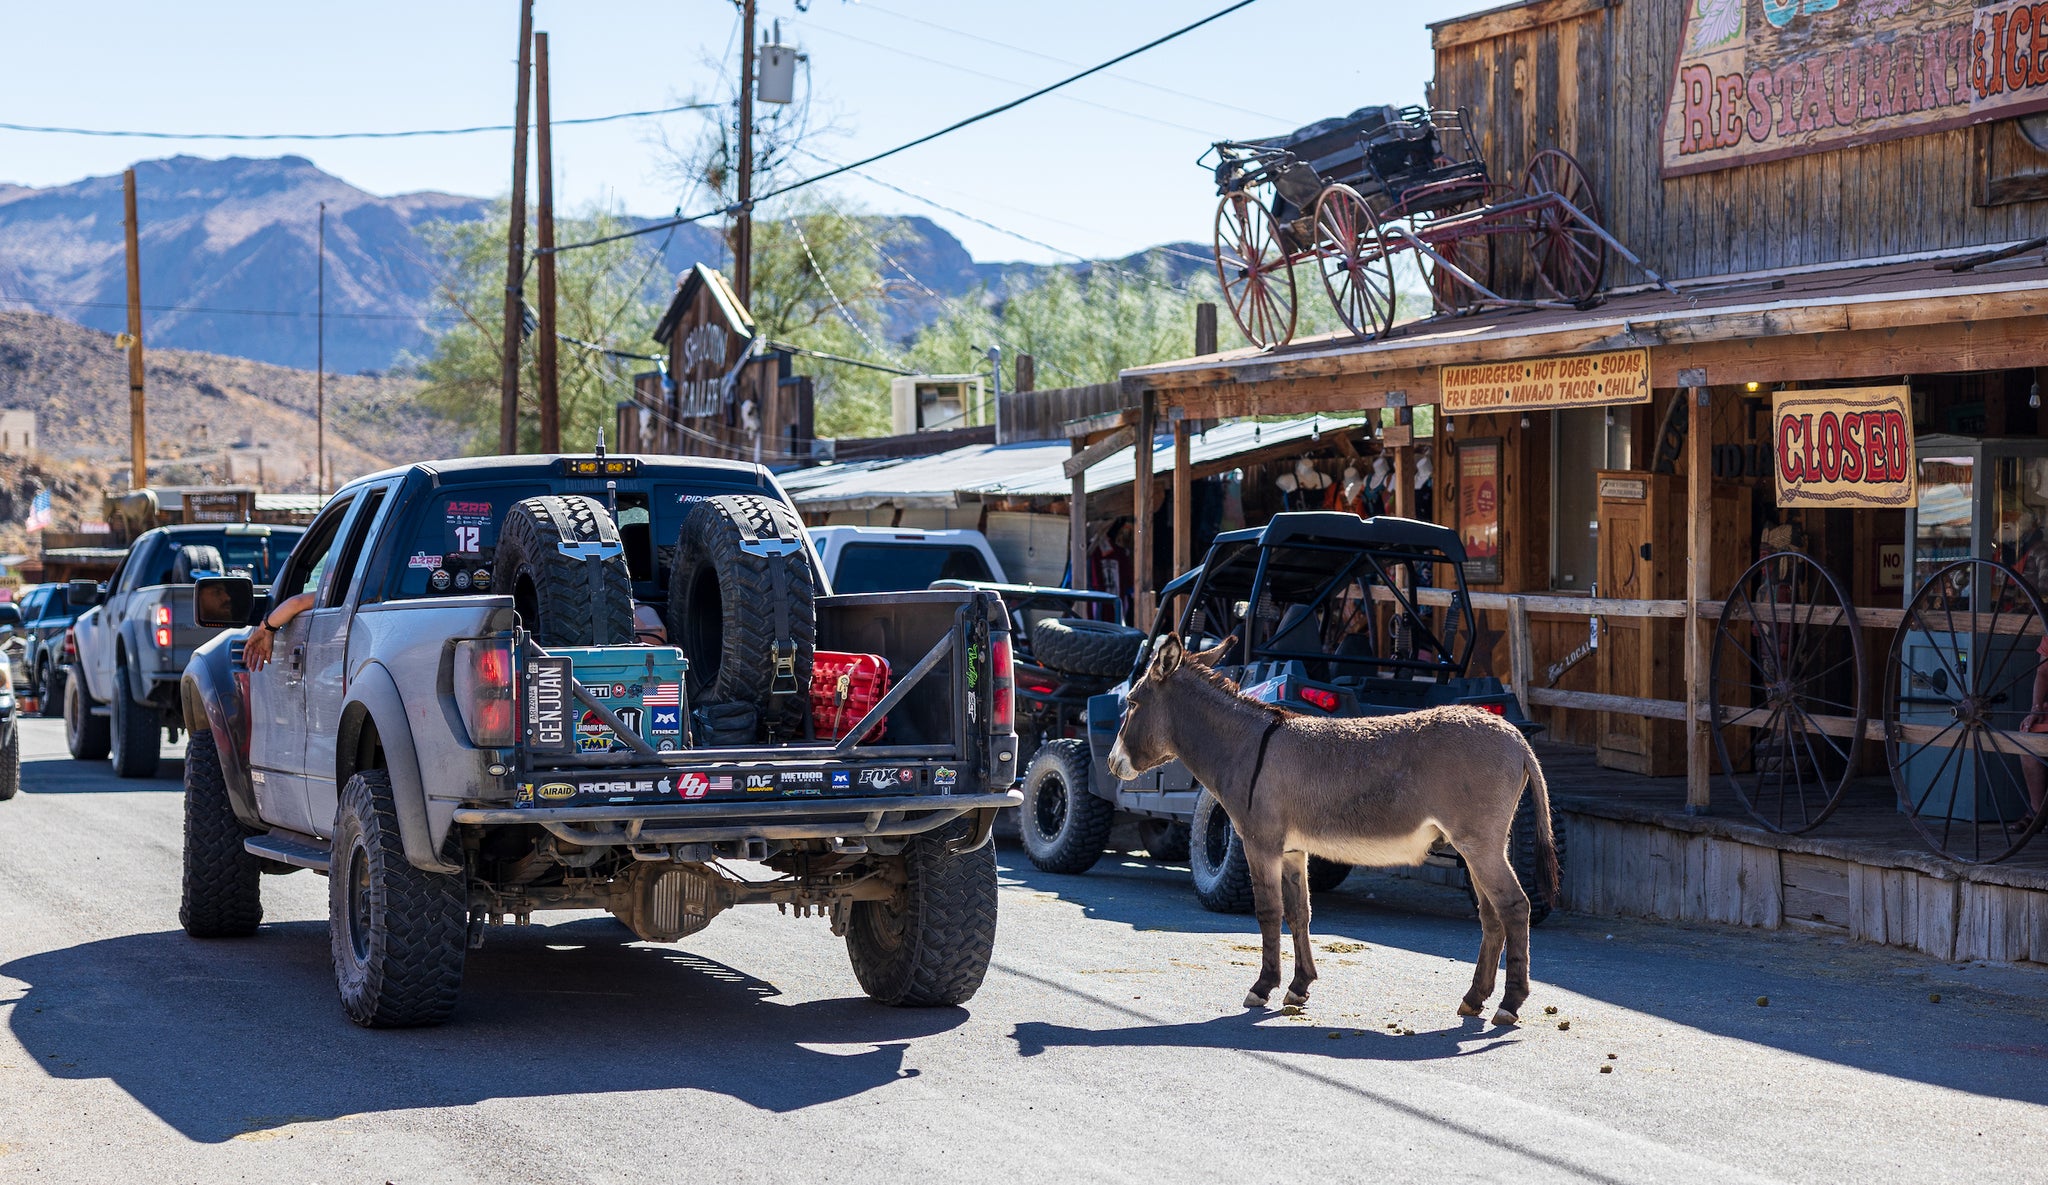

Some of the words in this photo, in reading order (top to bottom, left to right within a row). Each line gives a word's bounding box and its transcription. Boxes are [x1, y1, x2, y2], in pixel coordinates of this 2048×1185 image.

[1680, 25, 1972, 155] RESTAURANT
[1989, 0, 2048, 96] ICE
[1446, 364, 1523, 387] HAMBURGERS
[1533, 360, 1556, 380] HOT
[1559, 358, 1591, 379] DOGS
[1601, 353, 1641, 374] SODAS
[1446, 390, 1467, 407] FRY
[1469, 387, 1503, 406] BREAD
[1512, 384, 1554, 403] NAVAJO
[1559, 379, 1596, 400] TACOS
[1604, 376, 1636, 397] CHILI
[1777, 410, 1908, 483] CLOSED
[447, 502, 489, 511] AZRR
[455, 526, 480, 552] 12
[1883, 553, 1900, 568] NO
[1565, 641, 1590, 667] LOCAL
[529, 689, 538, 721] ARIZONA
[539, 666, 563, 743] GENJUAN
[579, 781, 653, 794] ROGUE
[781, 771, 823, 779] METHOD
[859, 768, 898, 788] FOX
[543, 783, 572, 796] AIRAID
